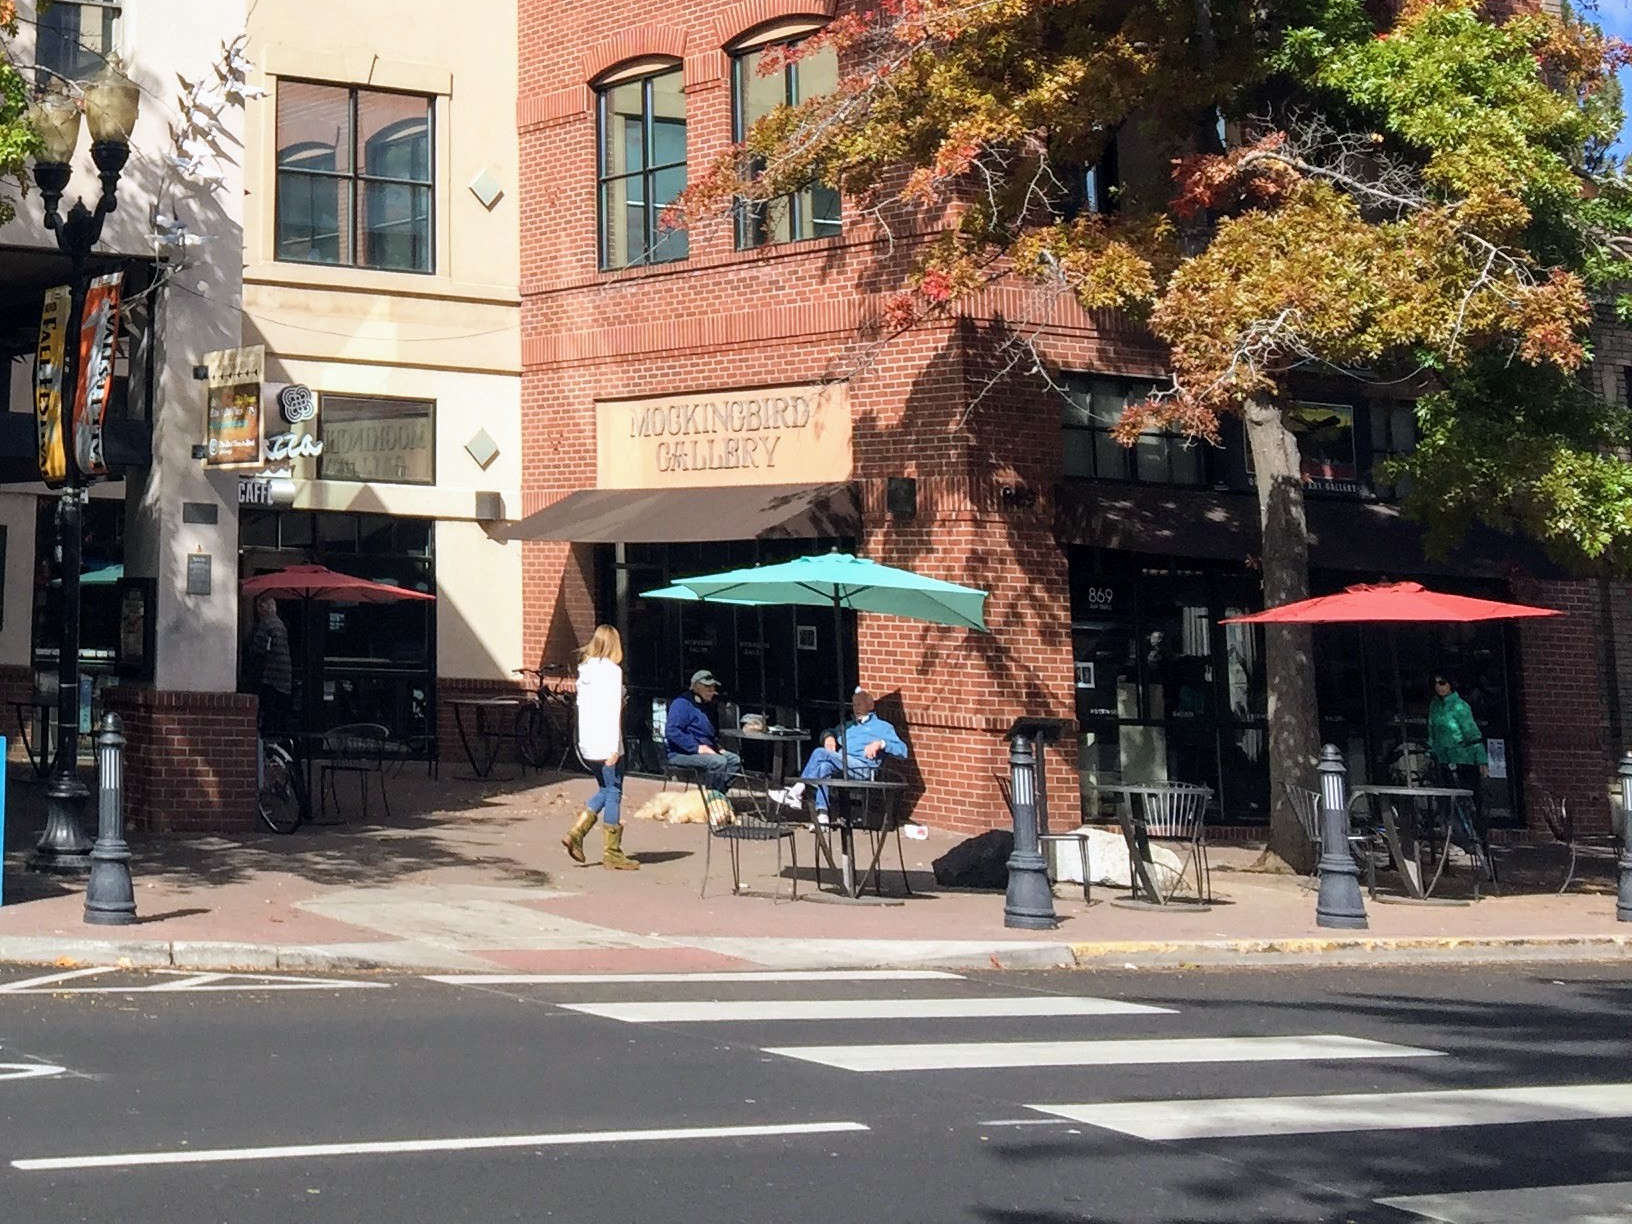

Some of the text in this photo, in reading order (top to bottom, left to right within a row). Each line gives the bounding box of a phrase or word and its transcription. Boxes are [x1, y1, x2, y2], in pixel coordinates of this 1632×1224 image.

[629, 395, 810, 438] MOCKINGBIRD
[655, 435, 781, 472] GALLERY
[1088, 587, 1113, 604] 869
